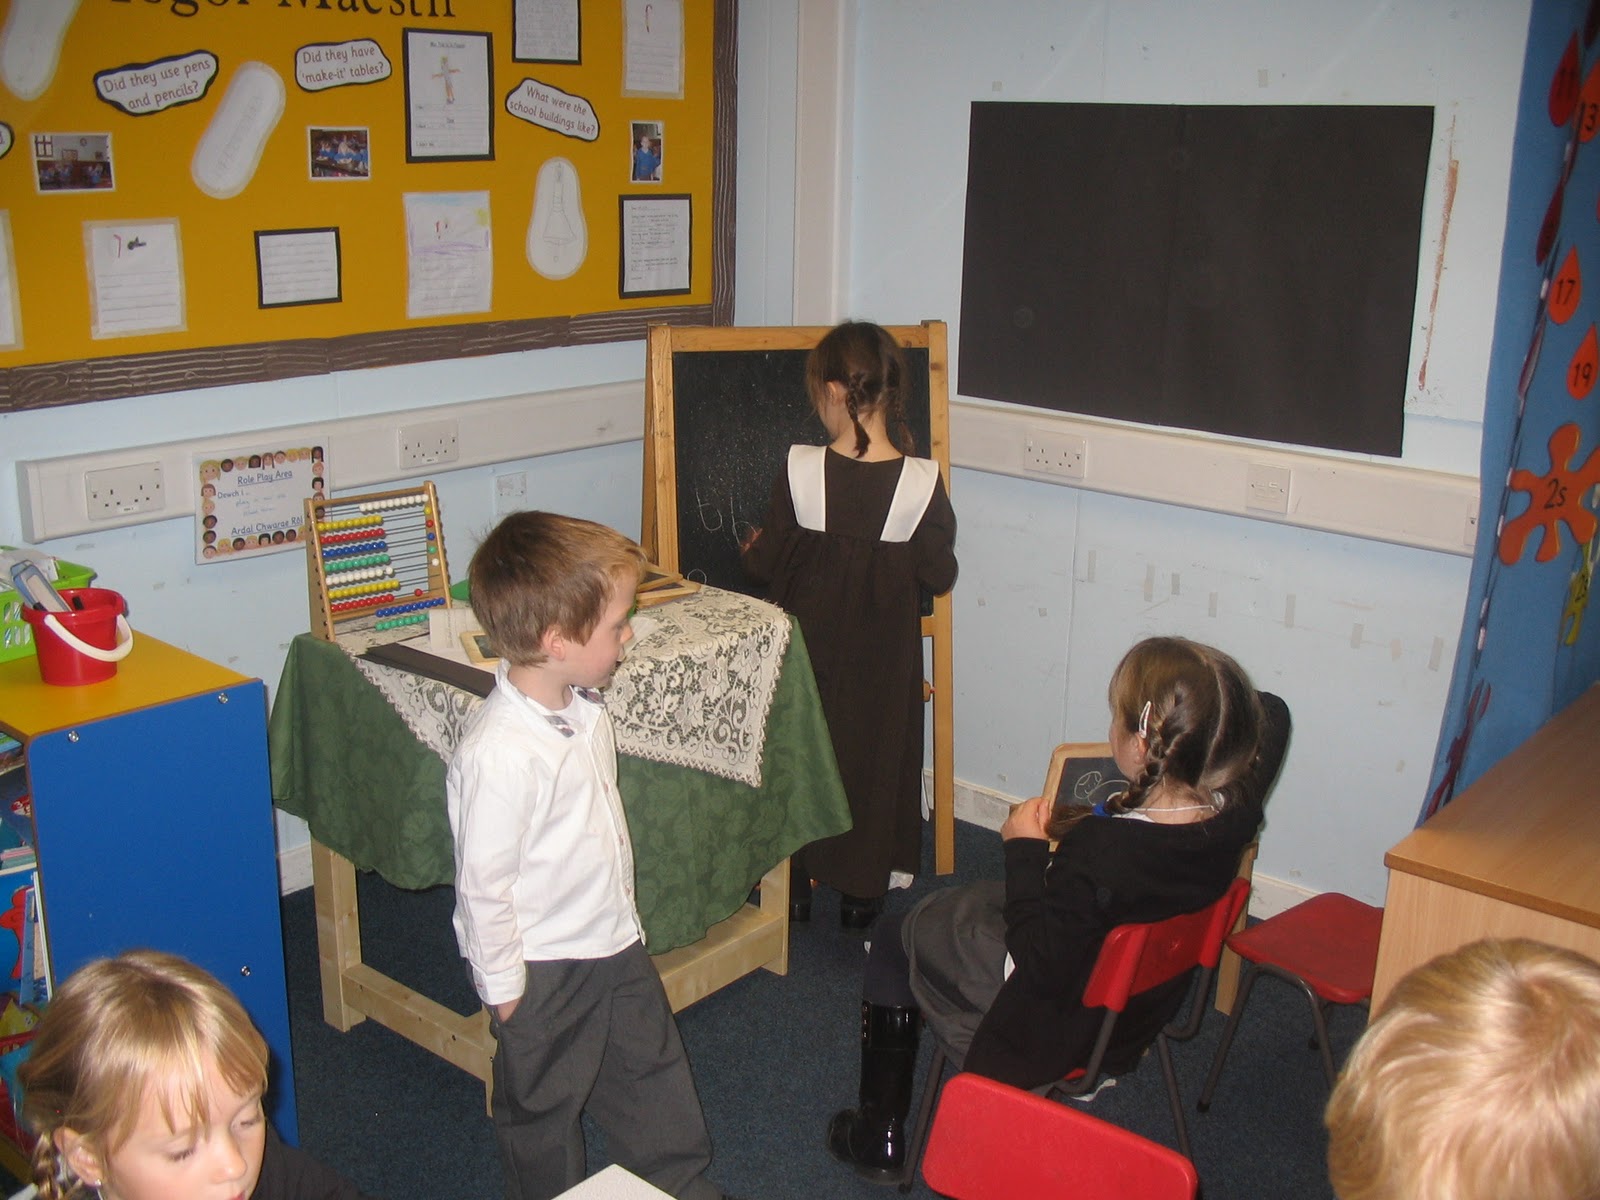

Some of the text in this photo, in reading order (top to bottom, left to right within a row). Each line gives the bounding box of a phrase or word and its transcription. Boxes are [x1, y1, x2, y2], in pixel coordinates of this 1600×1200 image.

[303, 45, 375, 64] Did they have
[103, 60, 210, 93] Did they use pens
[350, 61, 384, 77] tables?
[128, 80, 199, 109] and pencils?
[526, 85, 587, 116] What were the
[510, 100, 596, 135] school buildings like?
[1555, 278, 1576, 306] 17
[1573, 362, 1593, 388] 19
[237, 470, 293, 485] Role Play Area
[231, 524, 253, 535] Ardal
[256, 520, 289, 532] Chwarae
